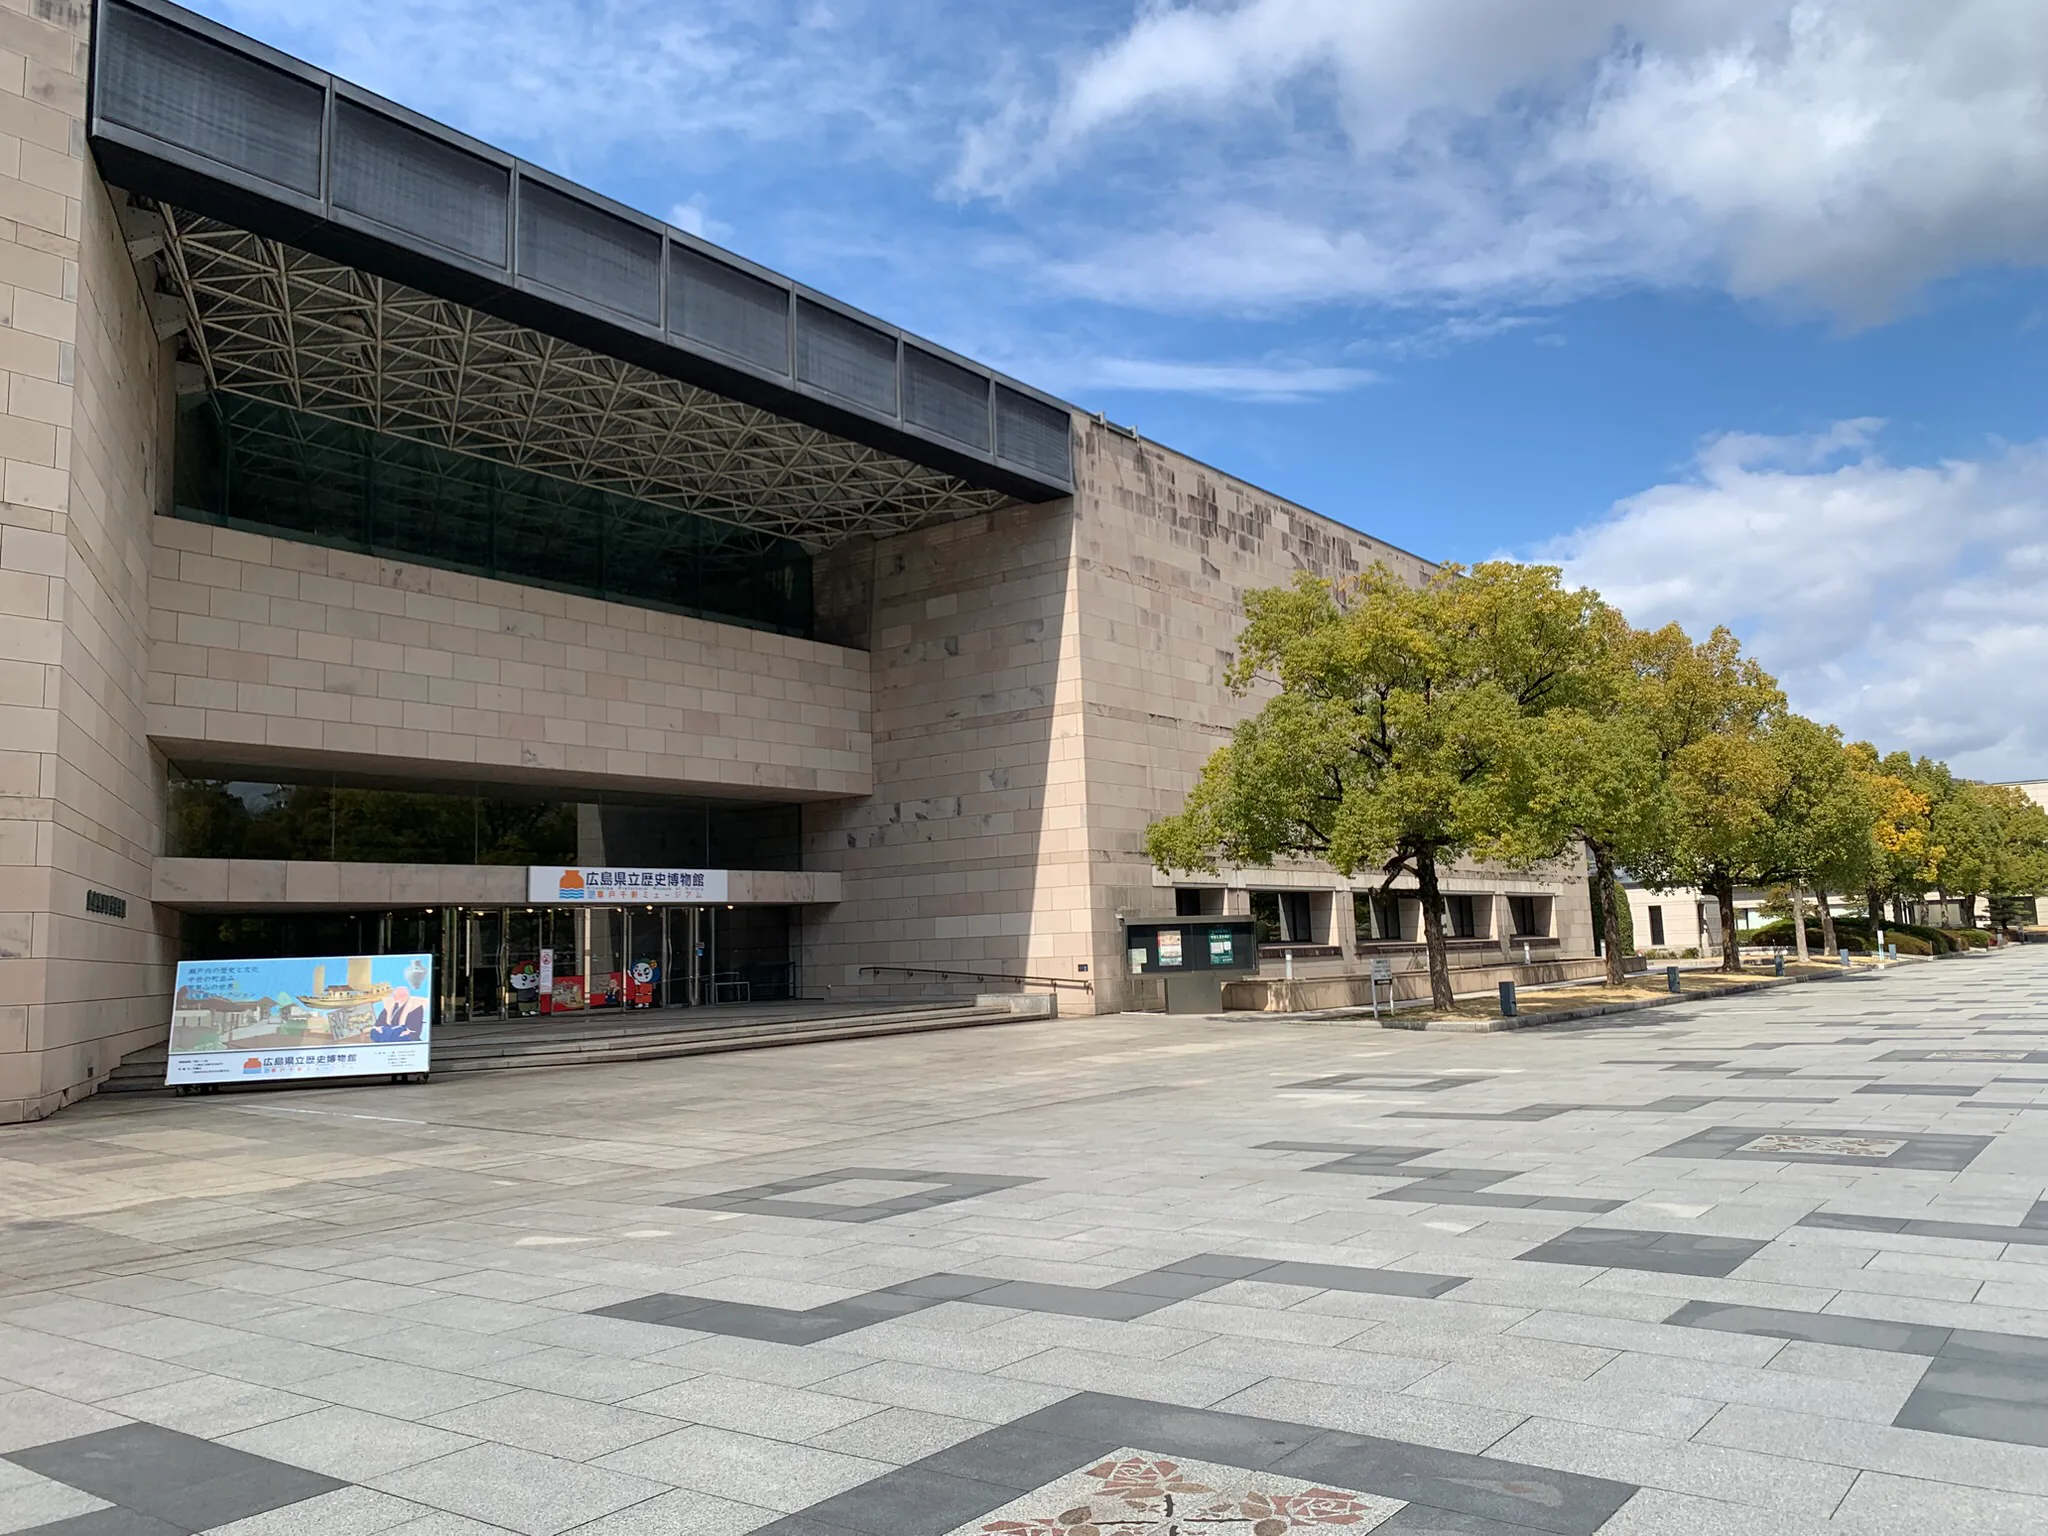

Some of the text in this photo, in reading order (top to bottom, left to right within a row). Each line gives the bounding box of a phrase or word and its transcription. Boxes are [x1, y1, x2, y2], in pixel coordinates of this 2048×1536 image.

[586, 872, 705, 887] 広島県立歴史博物館
[263, 1054, 358, 1067] 広島県立歴史博物館
